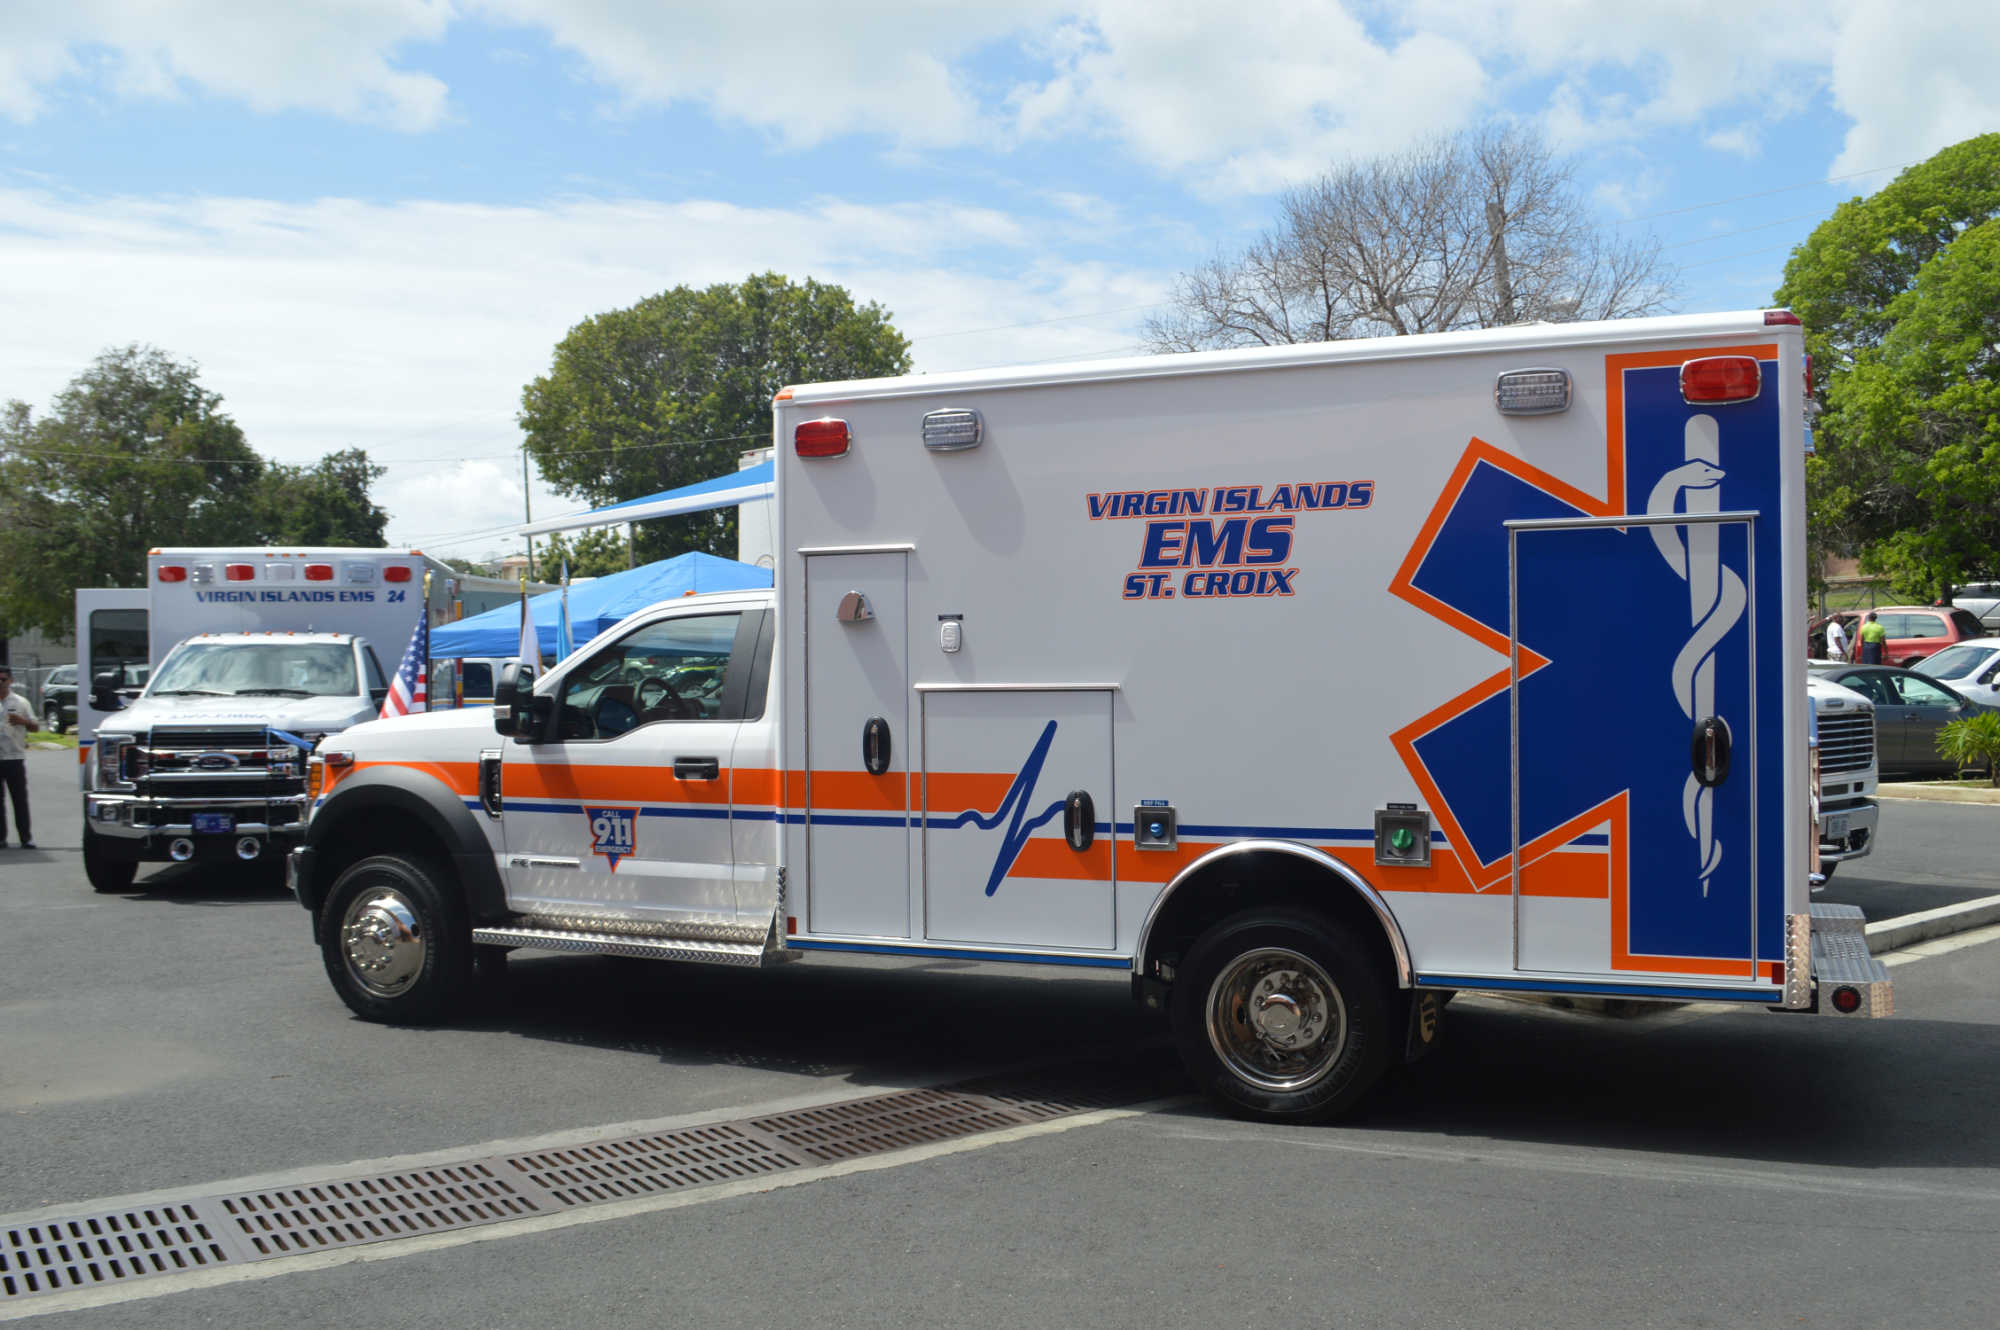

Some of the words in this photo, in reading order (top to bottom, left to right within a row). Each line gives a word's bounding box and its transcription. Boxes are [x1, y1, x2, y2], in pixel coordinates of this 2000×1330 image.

[1086, 488, 1209, 520] VIRGIN
[1209, 480, 1375, 515] ISLANDS
[1138, 515, 1296, 569] EMS
[196, 591, 256, 603] VIRGIN
[261, 591, 335, 603] ISLANDS
[339, 591, 375, 603] EMS
[386, 590, 406, 603] 24
[1122, 571, 1176, 600] ST.
[1182, 567, 1300, 599] CROIX
[602, 810, 621, 818] CALL
